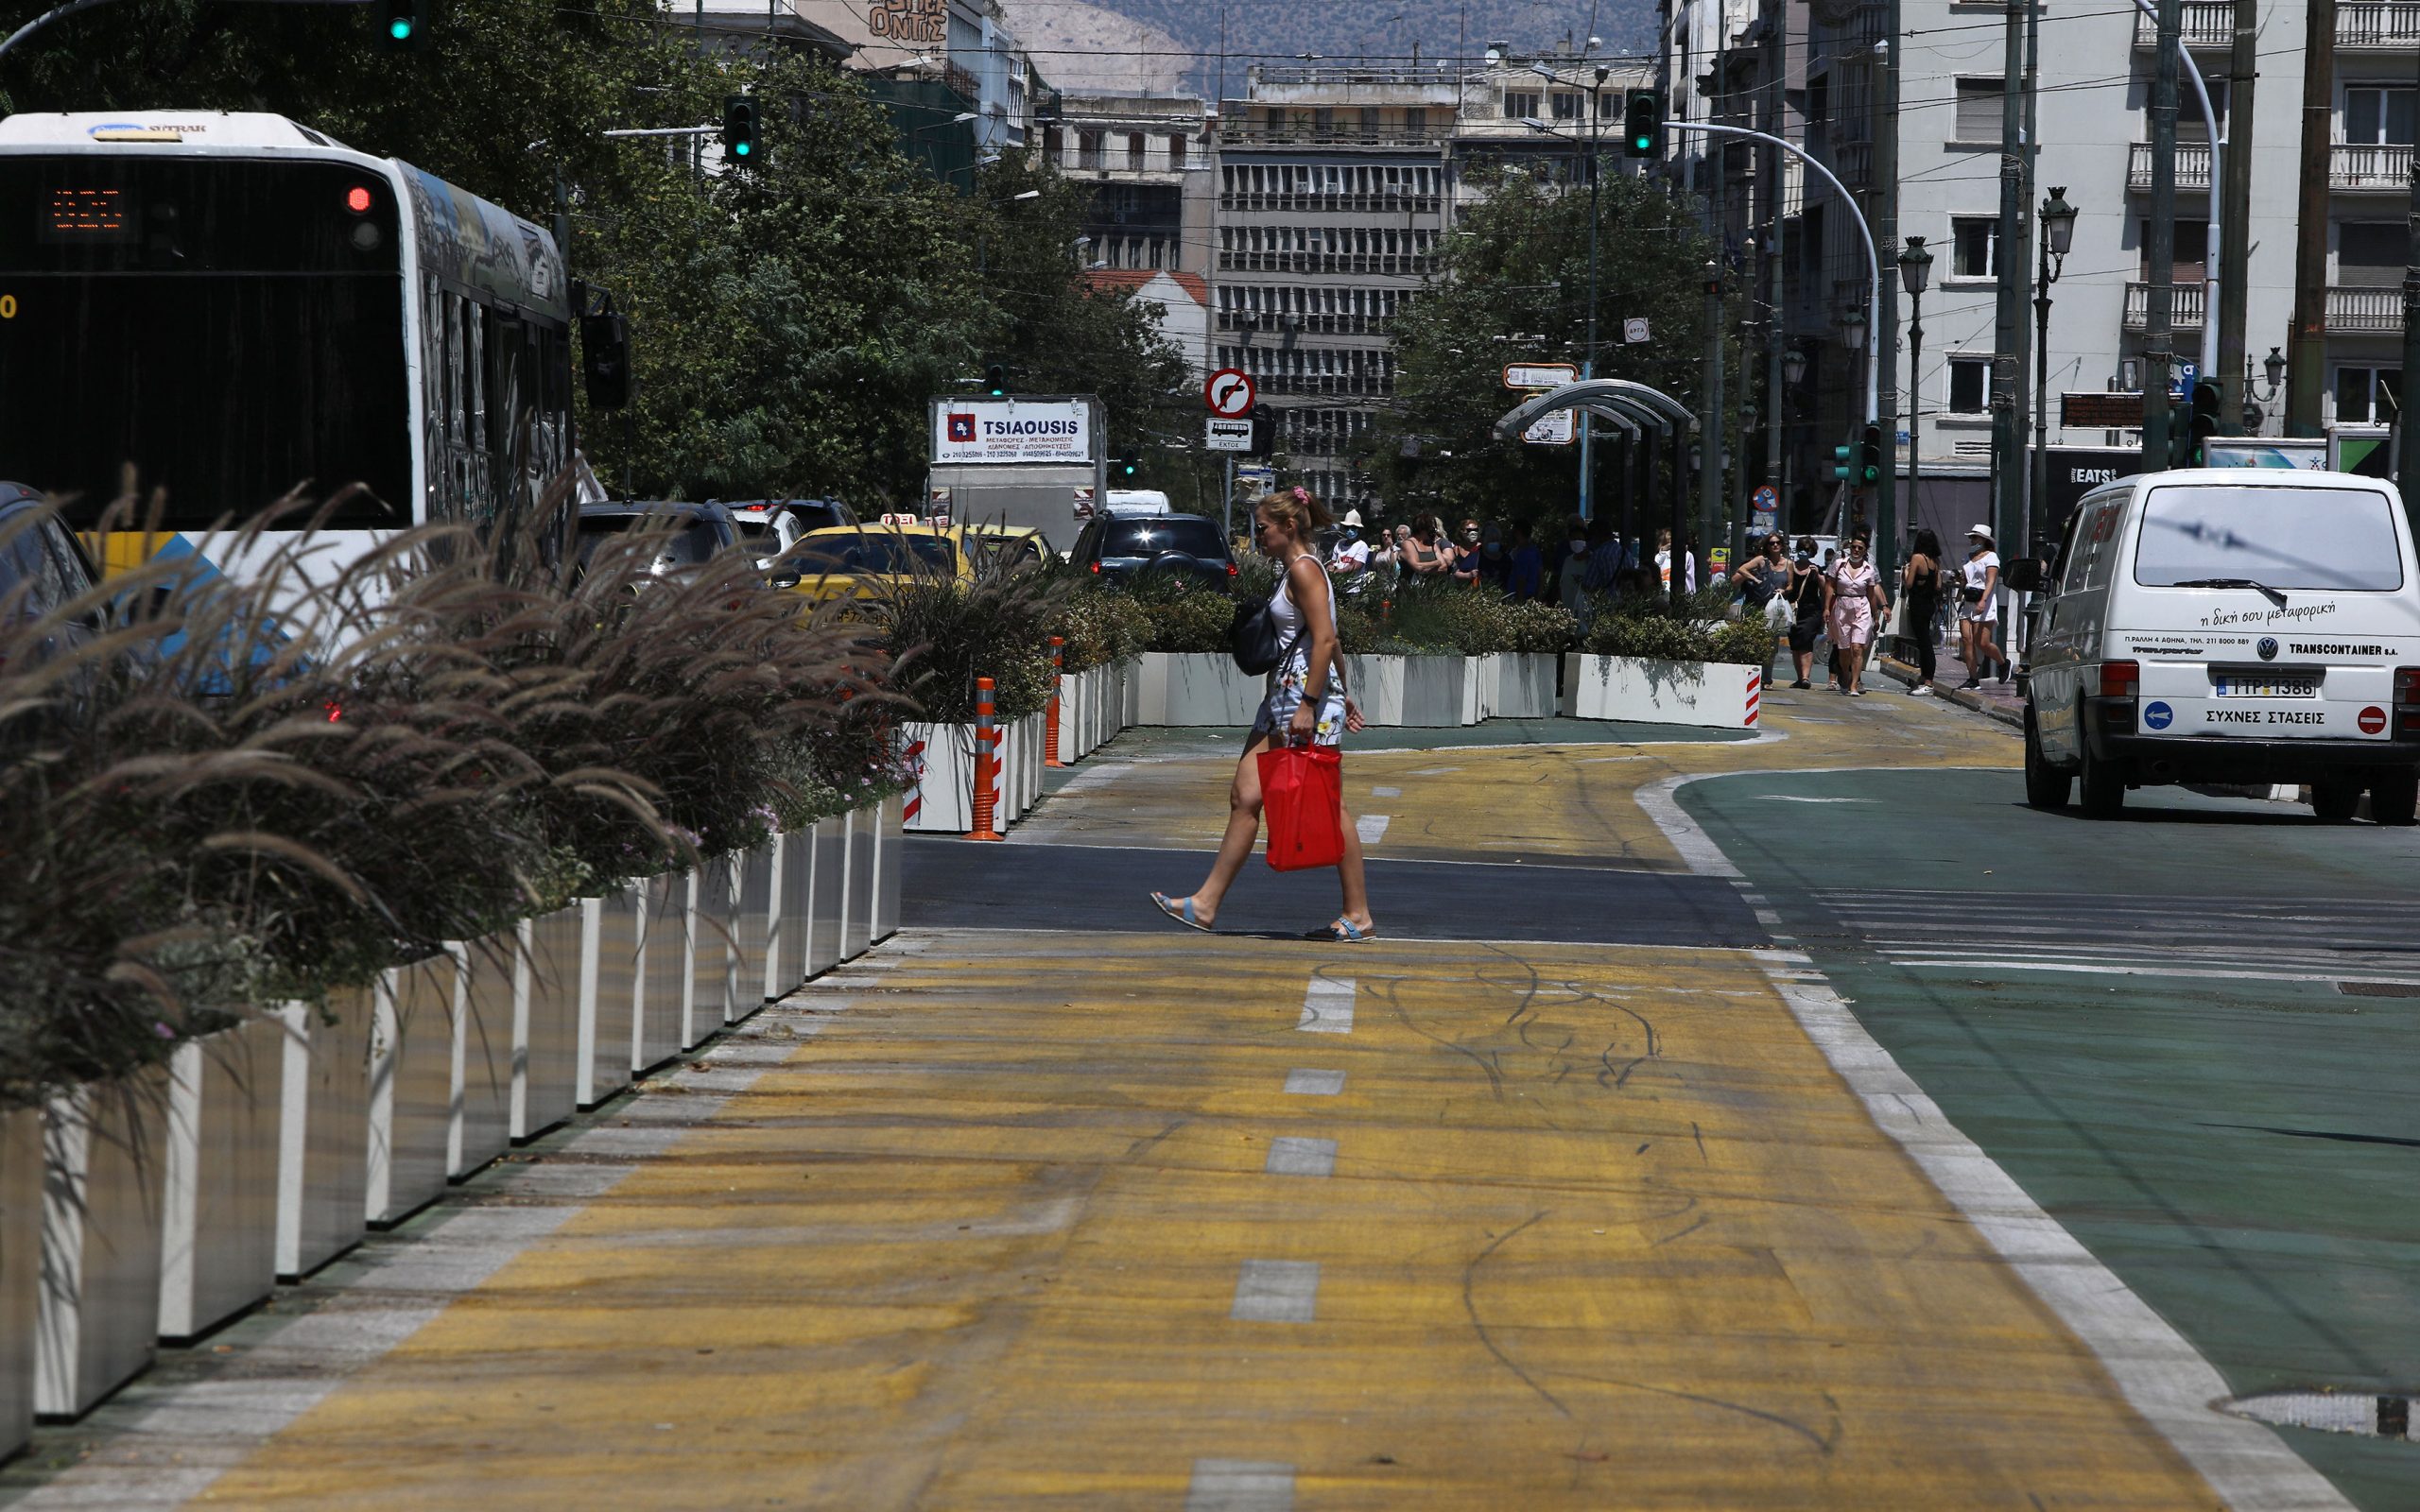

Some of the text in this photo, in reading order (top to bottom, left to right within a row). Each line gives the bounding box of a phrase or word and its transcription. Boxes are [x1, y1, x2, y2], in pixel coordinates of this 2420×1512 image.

[983, 421, 1079, 435] TSIAOUSIS
[2076, 469, 2111, 483] EATS
[2200, 601, 2336, 627] η δική σου μεταφορική
[2290, 644, 2382, 656] TRANSCONTAINER
[2206, 711, 2325, 725] ΣΥΧΝΕΣ ΣΤΑΣΕΙΣ
